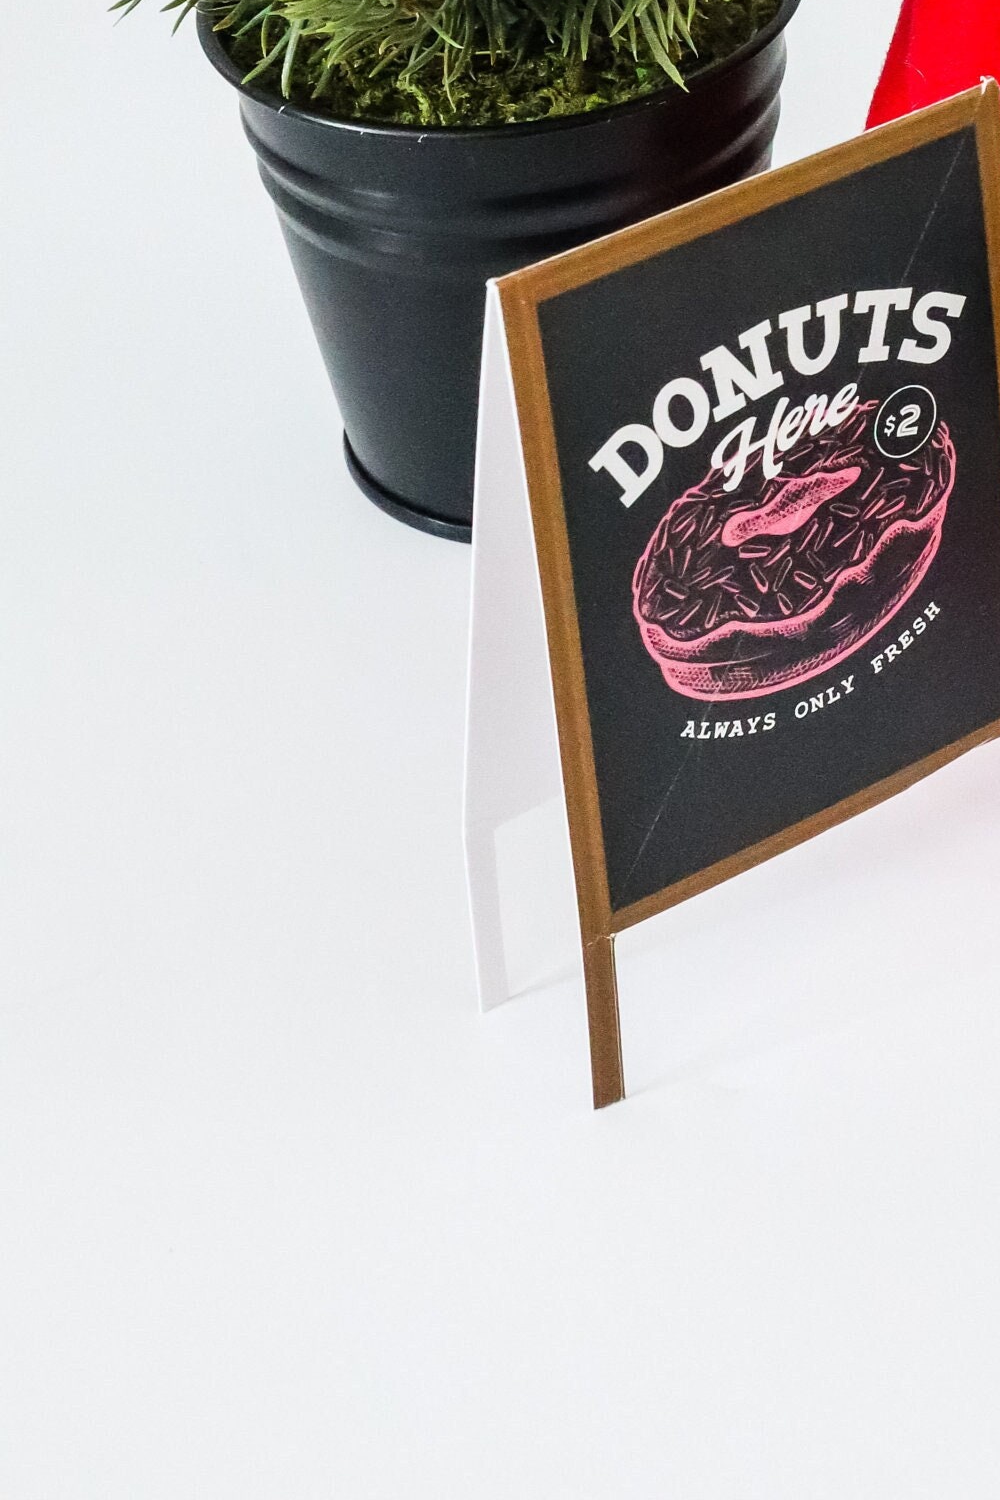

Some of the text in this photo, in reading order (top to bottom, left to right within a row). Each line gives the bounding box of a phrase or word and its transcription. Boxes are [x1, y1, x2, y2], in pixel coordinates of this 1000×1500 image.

[588, 287, 967, 508] DONUTS
[710, 382, 860, 492] Here
[884, 403, 921, 439] $2
[680, 601, 942, 740] ALWAYS ONLY FRESH
